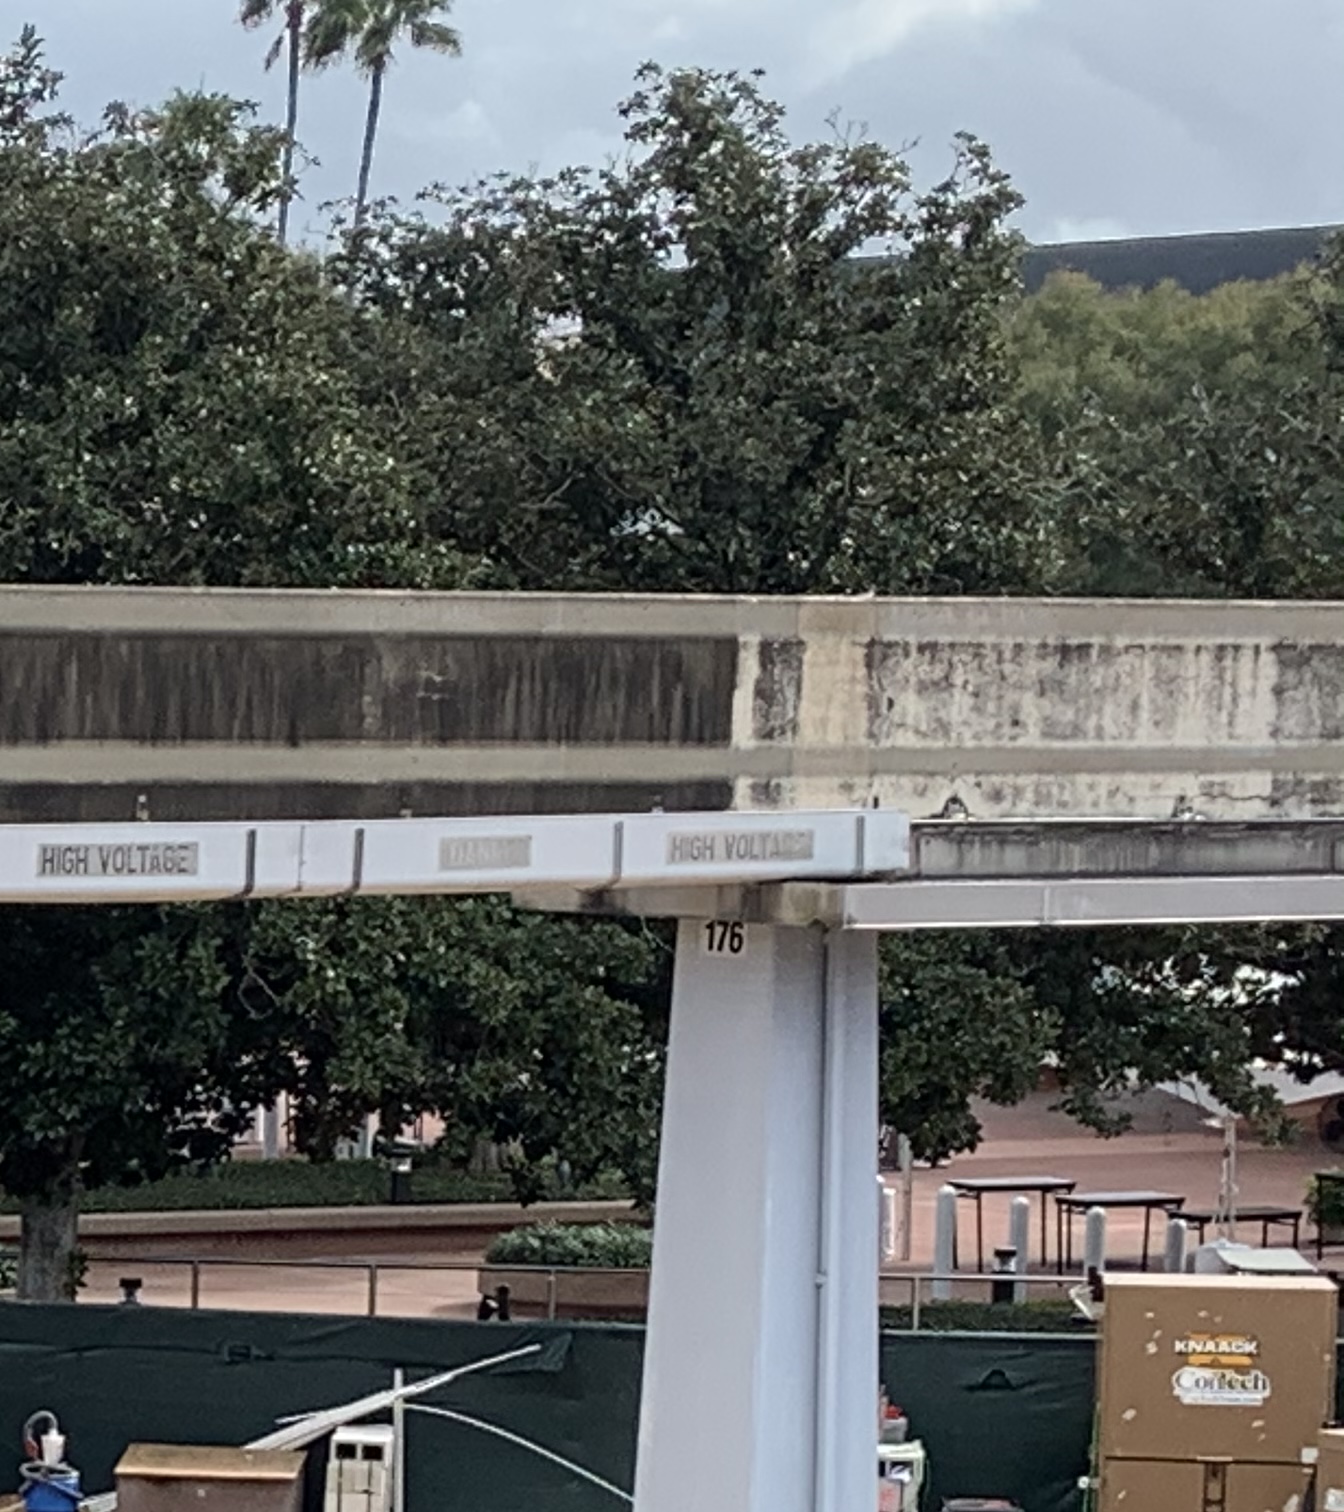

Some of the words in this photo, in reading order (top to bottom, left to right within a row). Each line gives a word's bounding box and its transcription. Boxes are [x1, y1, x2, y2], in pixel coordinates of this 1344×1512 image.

[42, 846, 89, 874] HIGH
[99, 844, 188, 874] VOLTAGE
[671, 835, 715, 861] HIGH
[725, 832, 806, 860] VOLTA
[705, 920, 743, 954] 176
[1175, 1340, 1258, 1354] KNAACK
